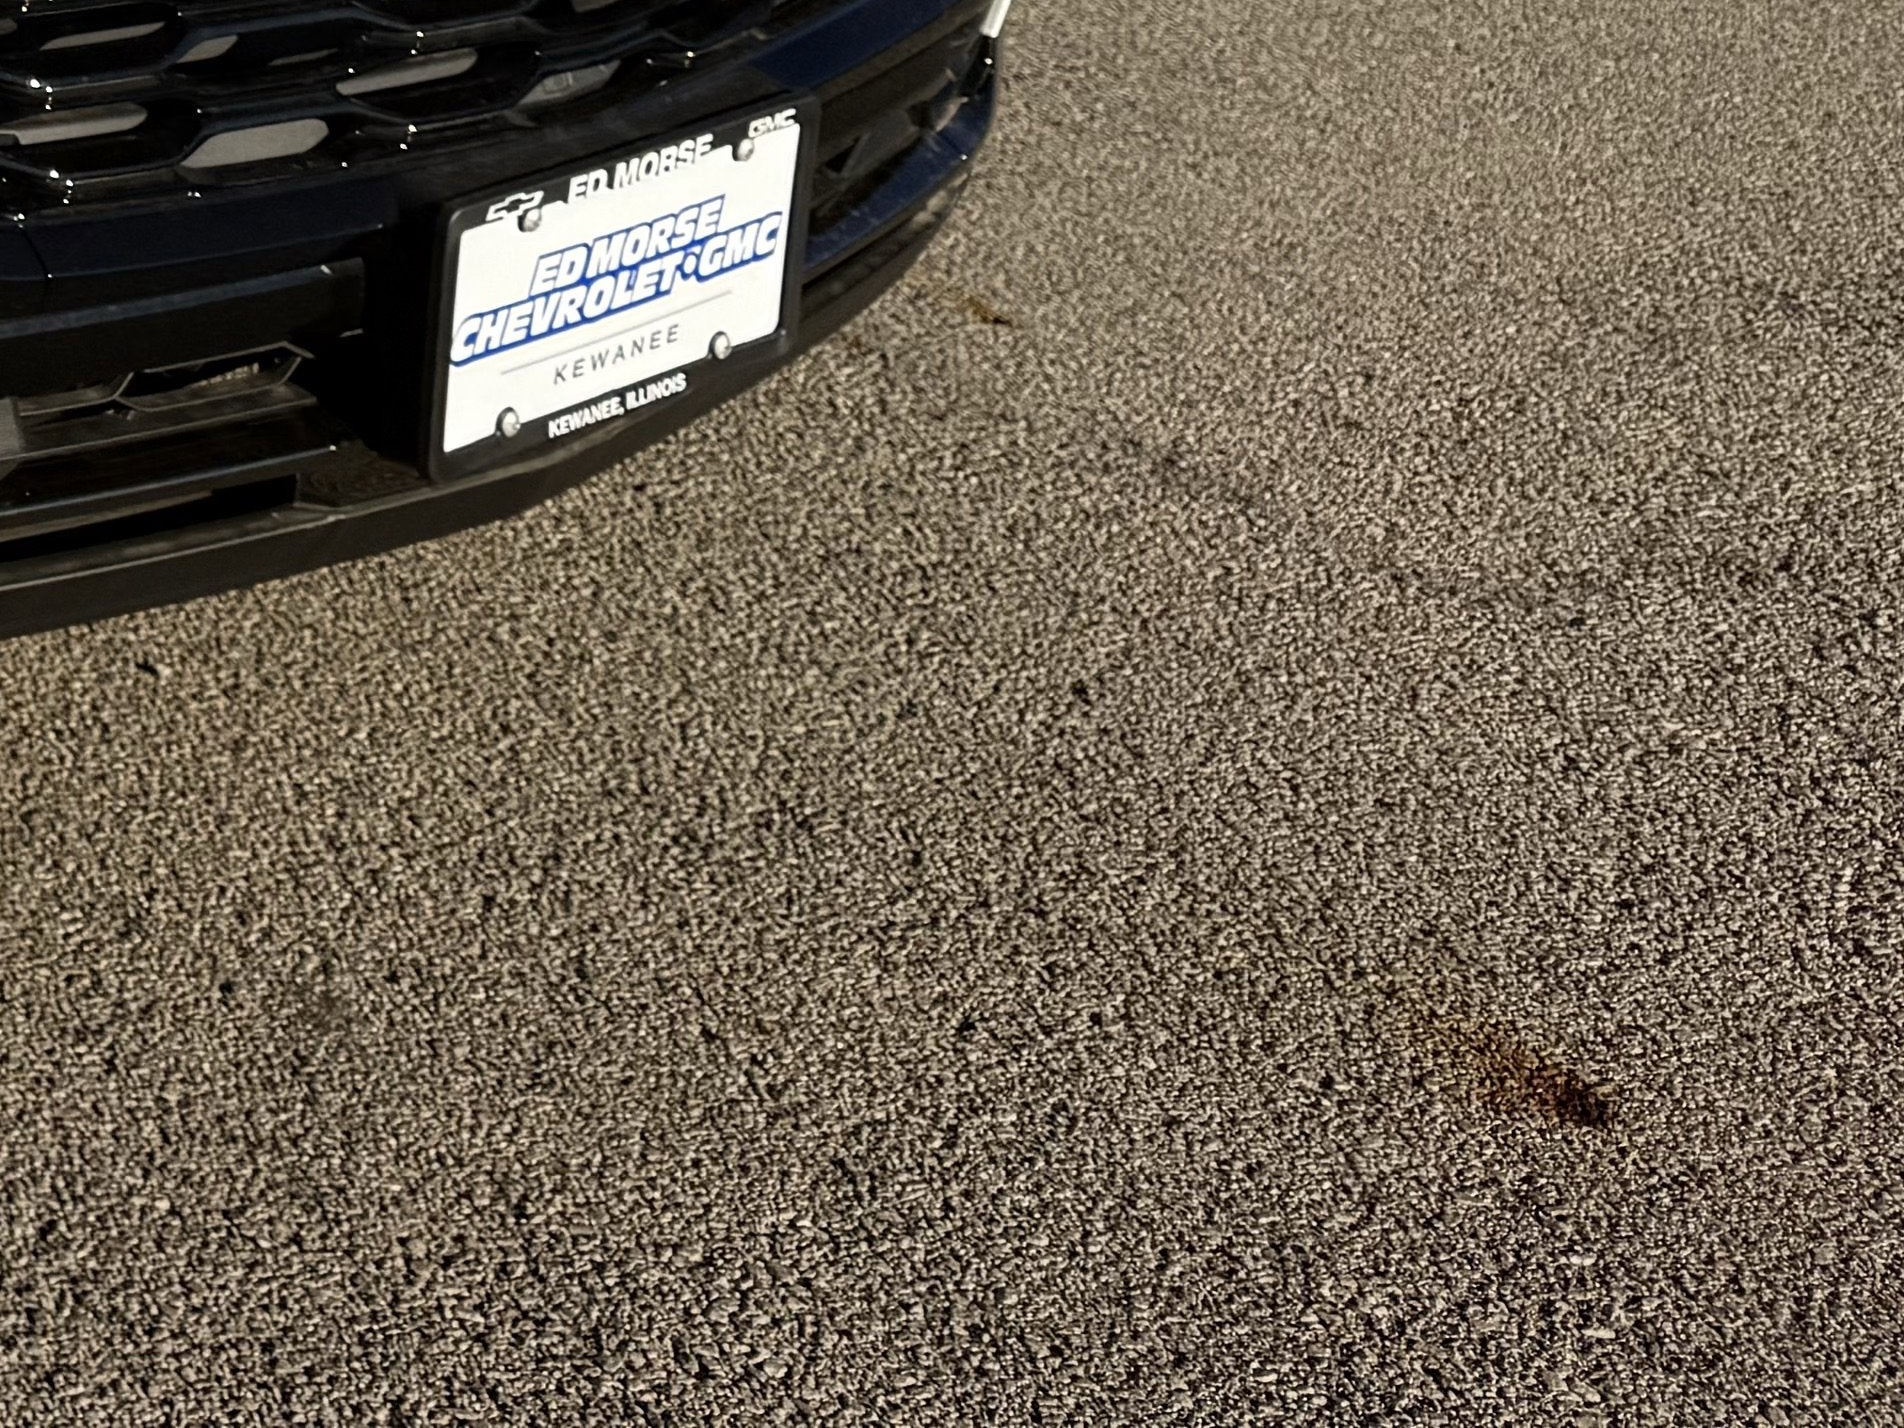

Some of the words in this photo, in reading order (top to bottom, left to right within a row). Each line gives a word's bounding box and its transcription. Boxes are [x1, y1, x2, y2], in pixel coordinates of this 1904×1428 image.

[748, 108, 797, 138] GMC
[568, 169, 609, 204] ED
[613, 133, 714, 189] MORSE
[553, 323, 680, 385] KEWANEE
[548, 396, 625, 439] KEWANEE,
[625, 372, 687, 411] ILLINOIS
